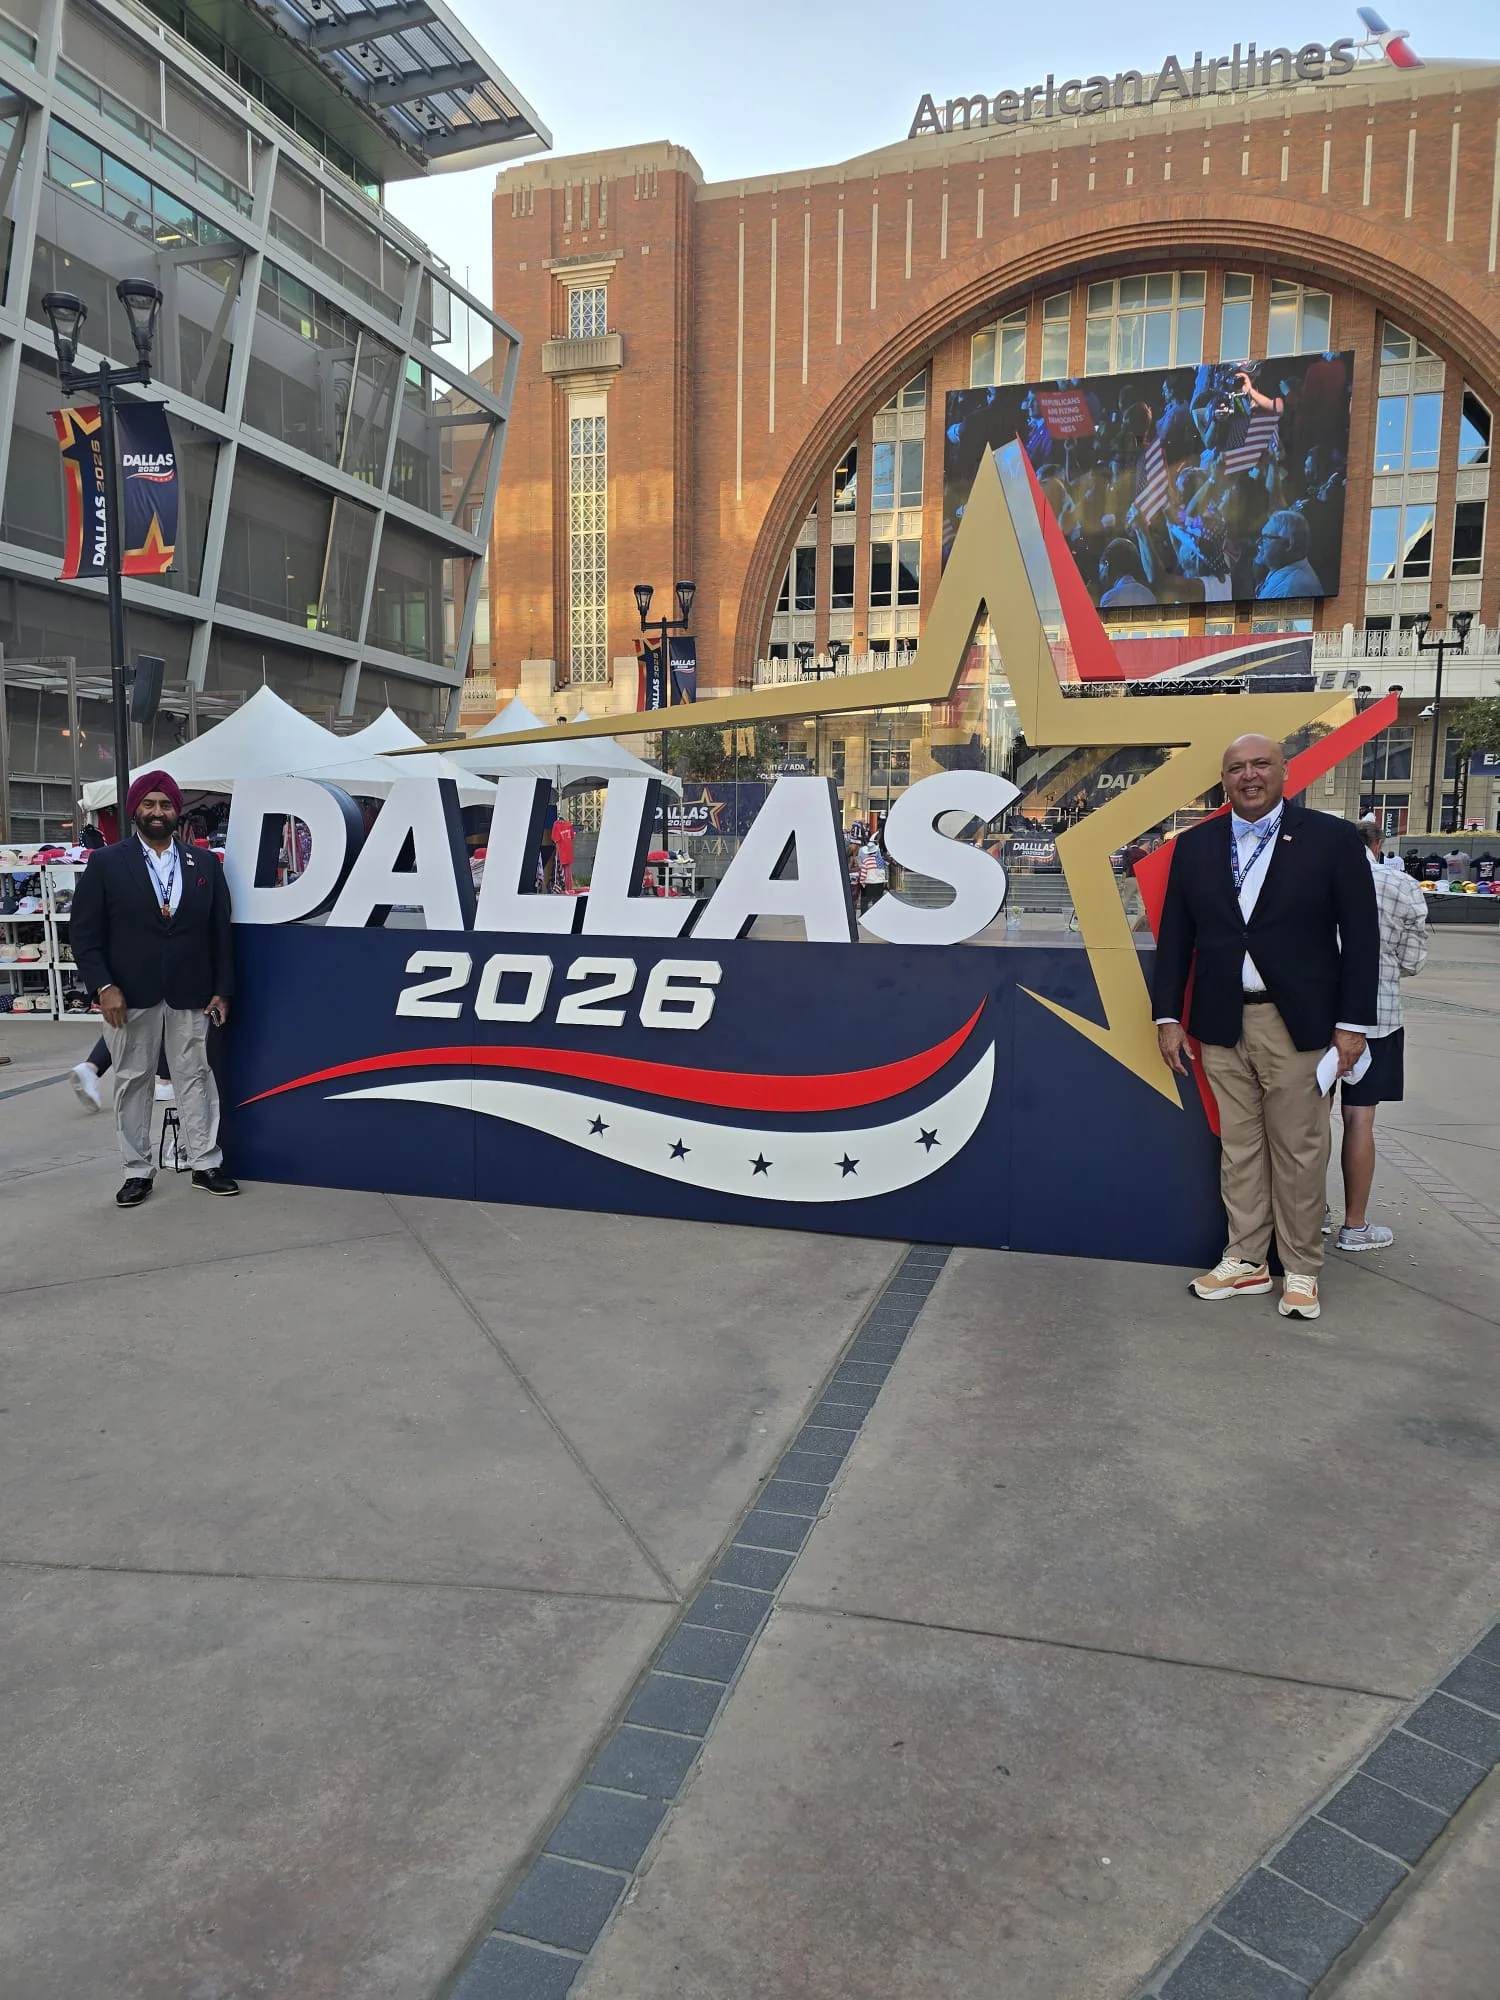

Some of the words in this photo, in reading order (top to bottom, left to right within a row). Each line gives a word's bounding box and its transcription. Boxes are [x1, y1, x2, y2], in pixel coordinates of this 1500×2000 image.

[908, 69, 1143, 139] American
[1152, 37, 1355, 99] Airlines
[91, 440, 105, 493] 2026
[123, 454, 173, 466] DALLAS
[93, 496, 107, 566] DALLAS
[1319, 670, 1361, 689] ER
[226, 769, 1022, 945] DALLAS
[395, 950, 722, 1031] 2026
